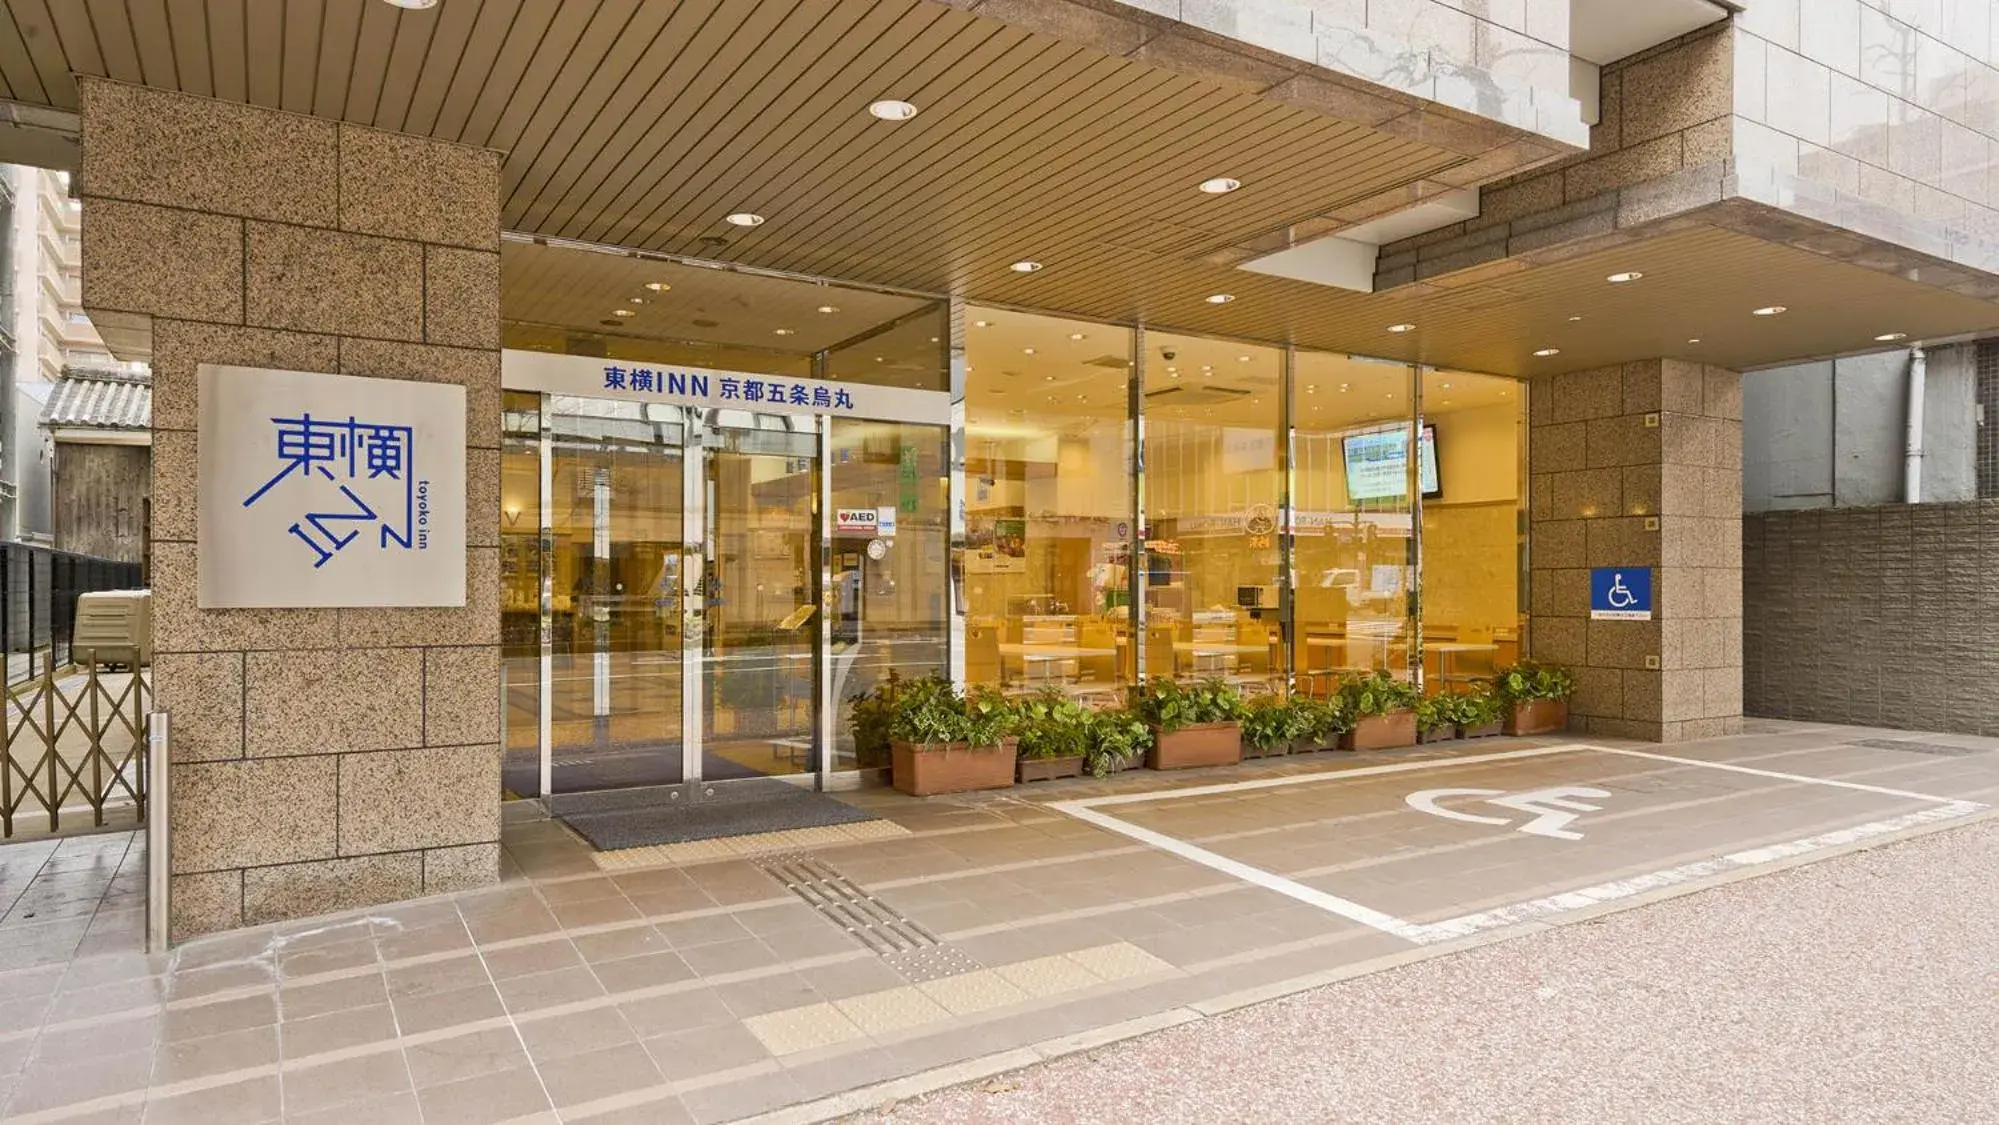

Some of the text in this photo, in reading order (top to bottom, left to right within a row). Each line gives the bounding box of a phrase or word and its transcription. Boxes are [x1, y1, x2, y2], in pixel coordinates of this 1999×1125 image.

[604, 367, 854, 409] 東横INN 京都五条烏丸
[416, 480, 430, 549] toyoko inn
[849, 512, 875, 521] AED
